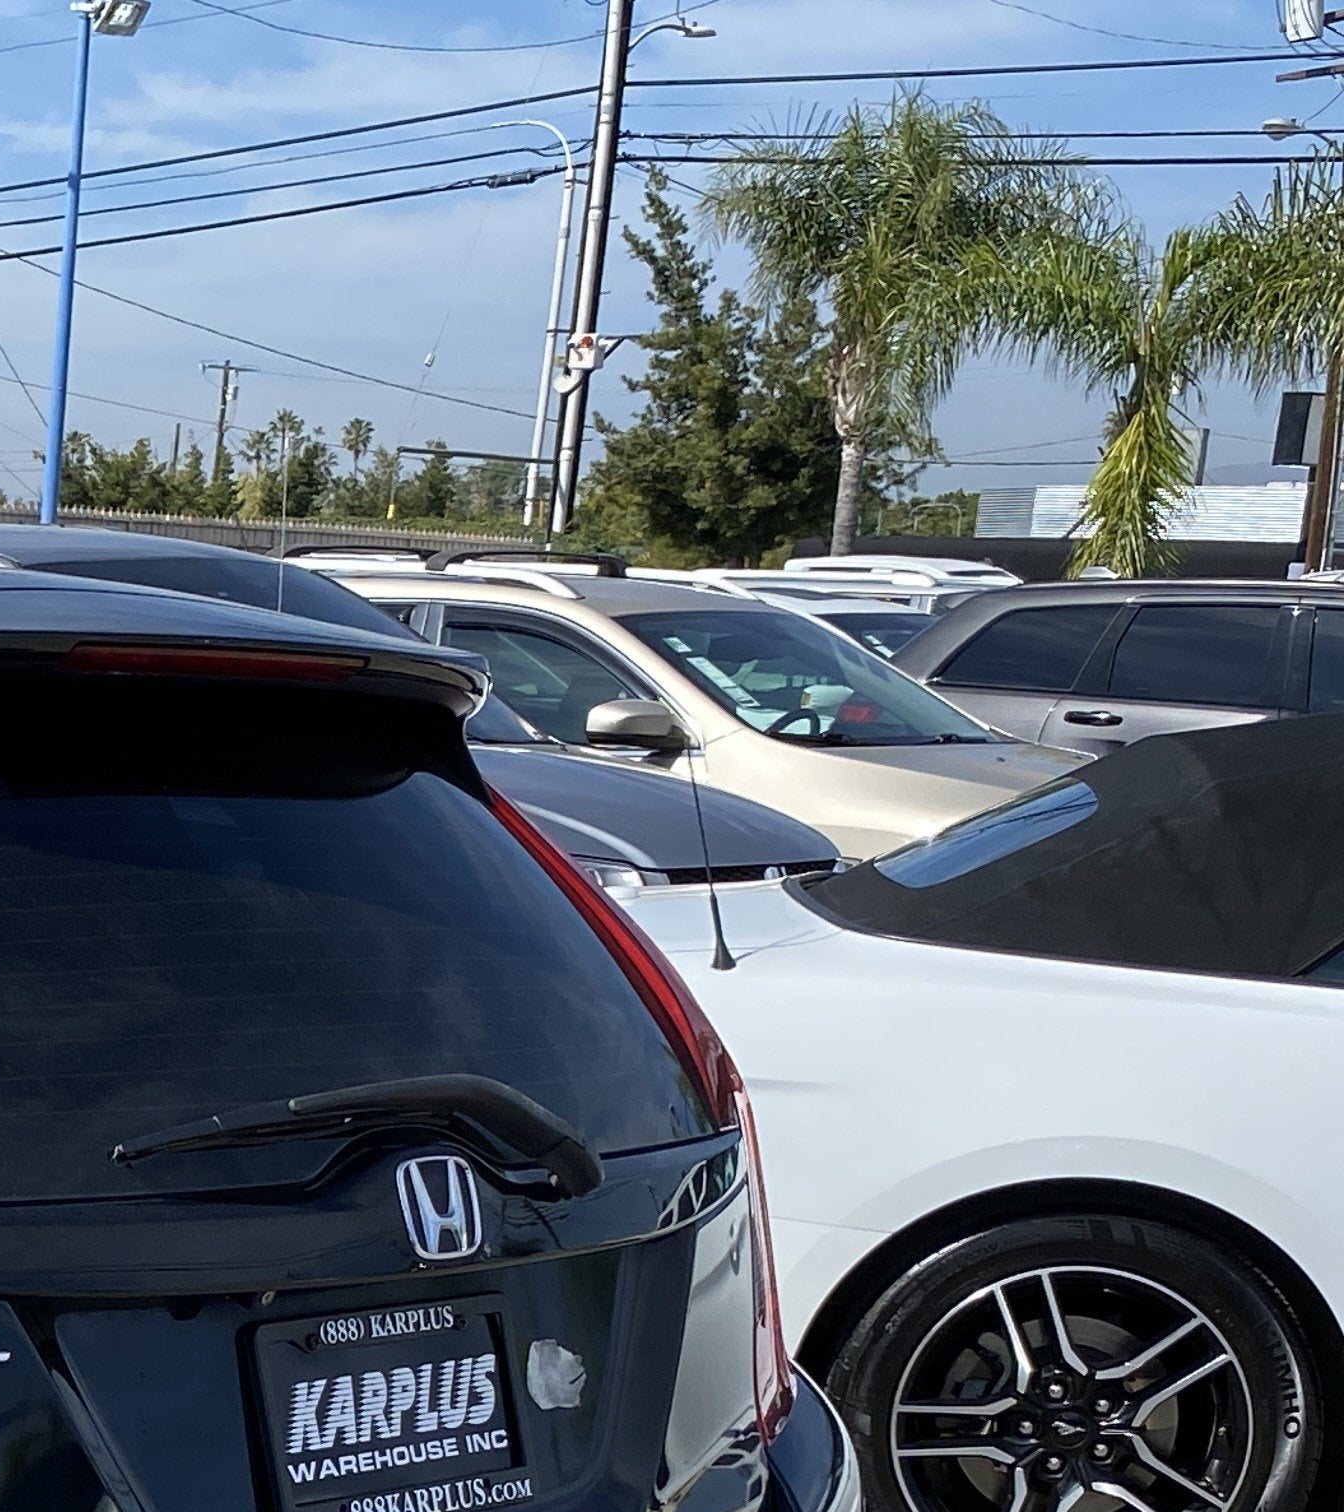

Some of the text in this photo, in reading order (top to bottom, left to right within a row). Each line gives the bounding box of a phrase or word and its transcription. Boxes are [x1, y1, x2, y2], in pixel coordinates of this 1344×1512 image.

[319, 1306, 455, 1345] (888) KARPLUS
[285, 1353, 496, 1454] KARPLUS
[287, 1429, 509, 1483] WAREHOUSE INC
